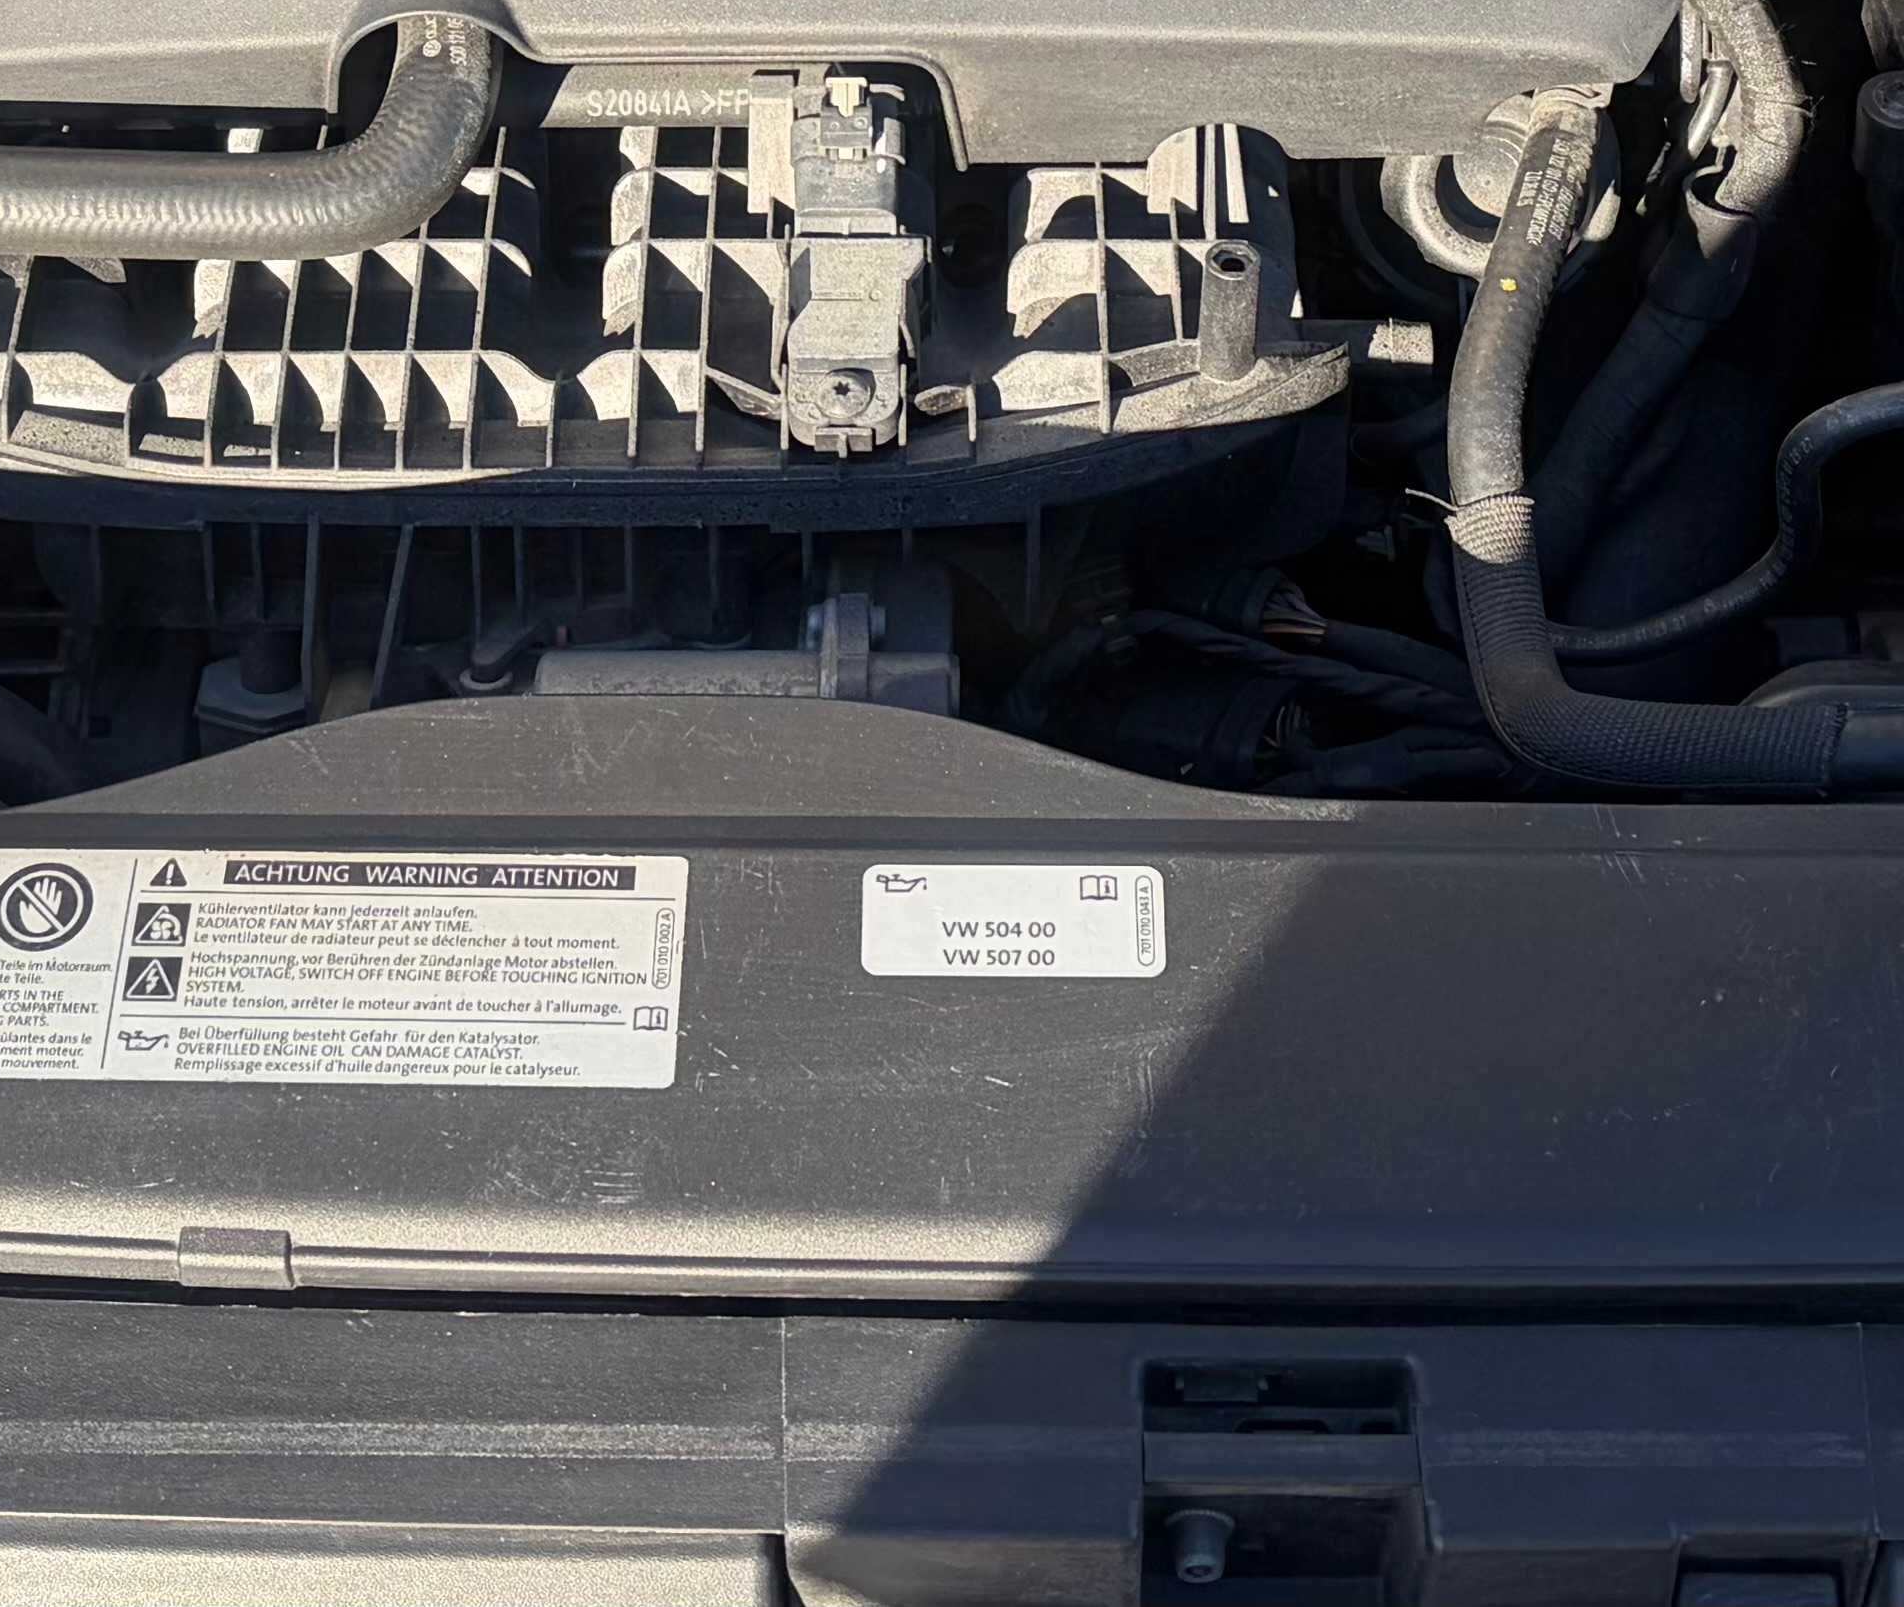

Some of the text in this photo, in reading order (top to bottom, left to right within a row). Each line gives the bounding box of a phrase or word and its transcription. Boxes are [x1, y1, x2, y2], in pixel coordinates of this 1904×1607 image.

[586, 88, 692, 117] S20841A
[233, 864, 620, 887] ACHTUNG WARNING ATTENTION
[198, 902, 478, 922] Kühlerventilator kann jederzeit anlaufen.
[660, 912, 672, 922] A
[1141, 885, 1152, 954] 701 010 043 A
[196, 917, 474, 933] RADIATOR FAN MAY START AT ANY TIME.
[942, 921, 1056, 938] VW 504 00
[193, 931, 621, 950] Le ventilateur de radiateur peut se déclencher à tout moment.
[658, 923, 672, 946] 002
[190, 951, 618, 973] Hochspannung, vor Berühren der Zündanlage Motor abstellen.
[943, 949, 1055, 965] VW 507 00
[0, 959, 25, 972] Teile
[27, 959, 43, 972] im
[45, 959, 113, 973] Motorraum.
[14, 972, 45, 985] Teile.
[188, 965, 647, 985] HIGH VOLTAGE, SWITCH OFF ENGINE BEFORE TOUCHING IGNITION
[22, 989, 37, 1001] IN
[39, 989, 64, 1001] THE
[186, 981, 246, 994] SYSTEM.
[2, 1001, 99, 1015] COMPARTMENT.
[183, 995, 622, 1017] Haute tension, arrêter le moteur avant de toucher à l'allumage.
[7, 1015, 51, 1027] PARTS.
[49, 1032, 78, 1045] dans
[80, 1033, 92, 1045] le
[179, 1025, 540, 1048] Bei Überfüllung besteht Gefahr für den Katalysator.
[36, 1045, 86, 1058] moteur.
[177, 1042, 524, 1060] OVERFILLED ENGINE OIL CAN DAMAGE CATALYST.
[0, 1058, 80, 1070] mouvement.
[174, 1058, 582, 1079] Remplissage excessif d'huile dangereux pour le catalyseur.
